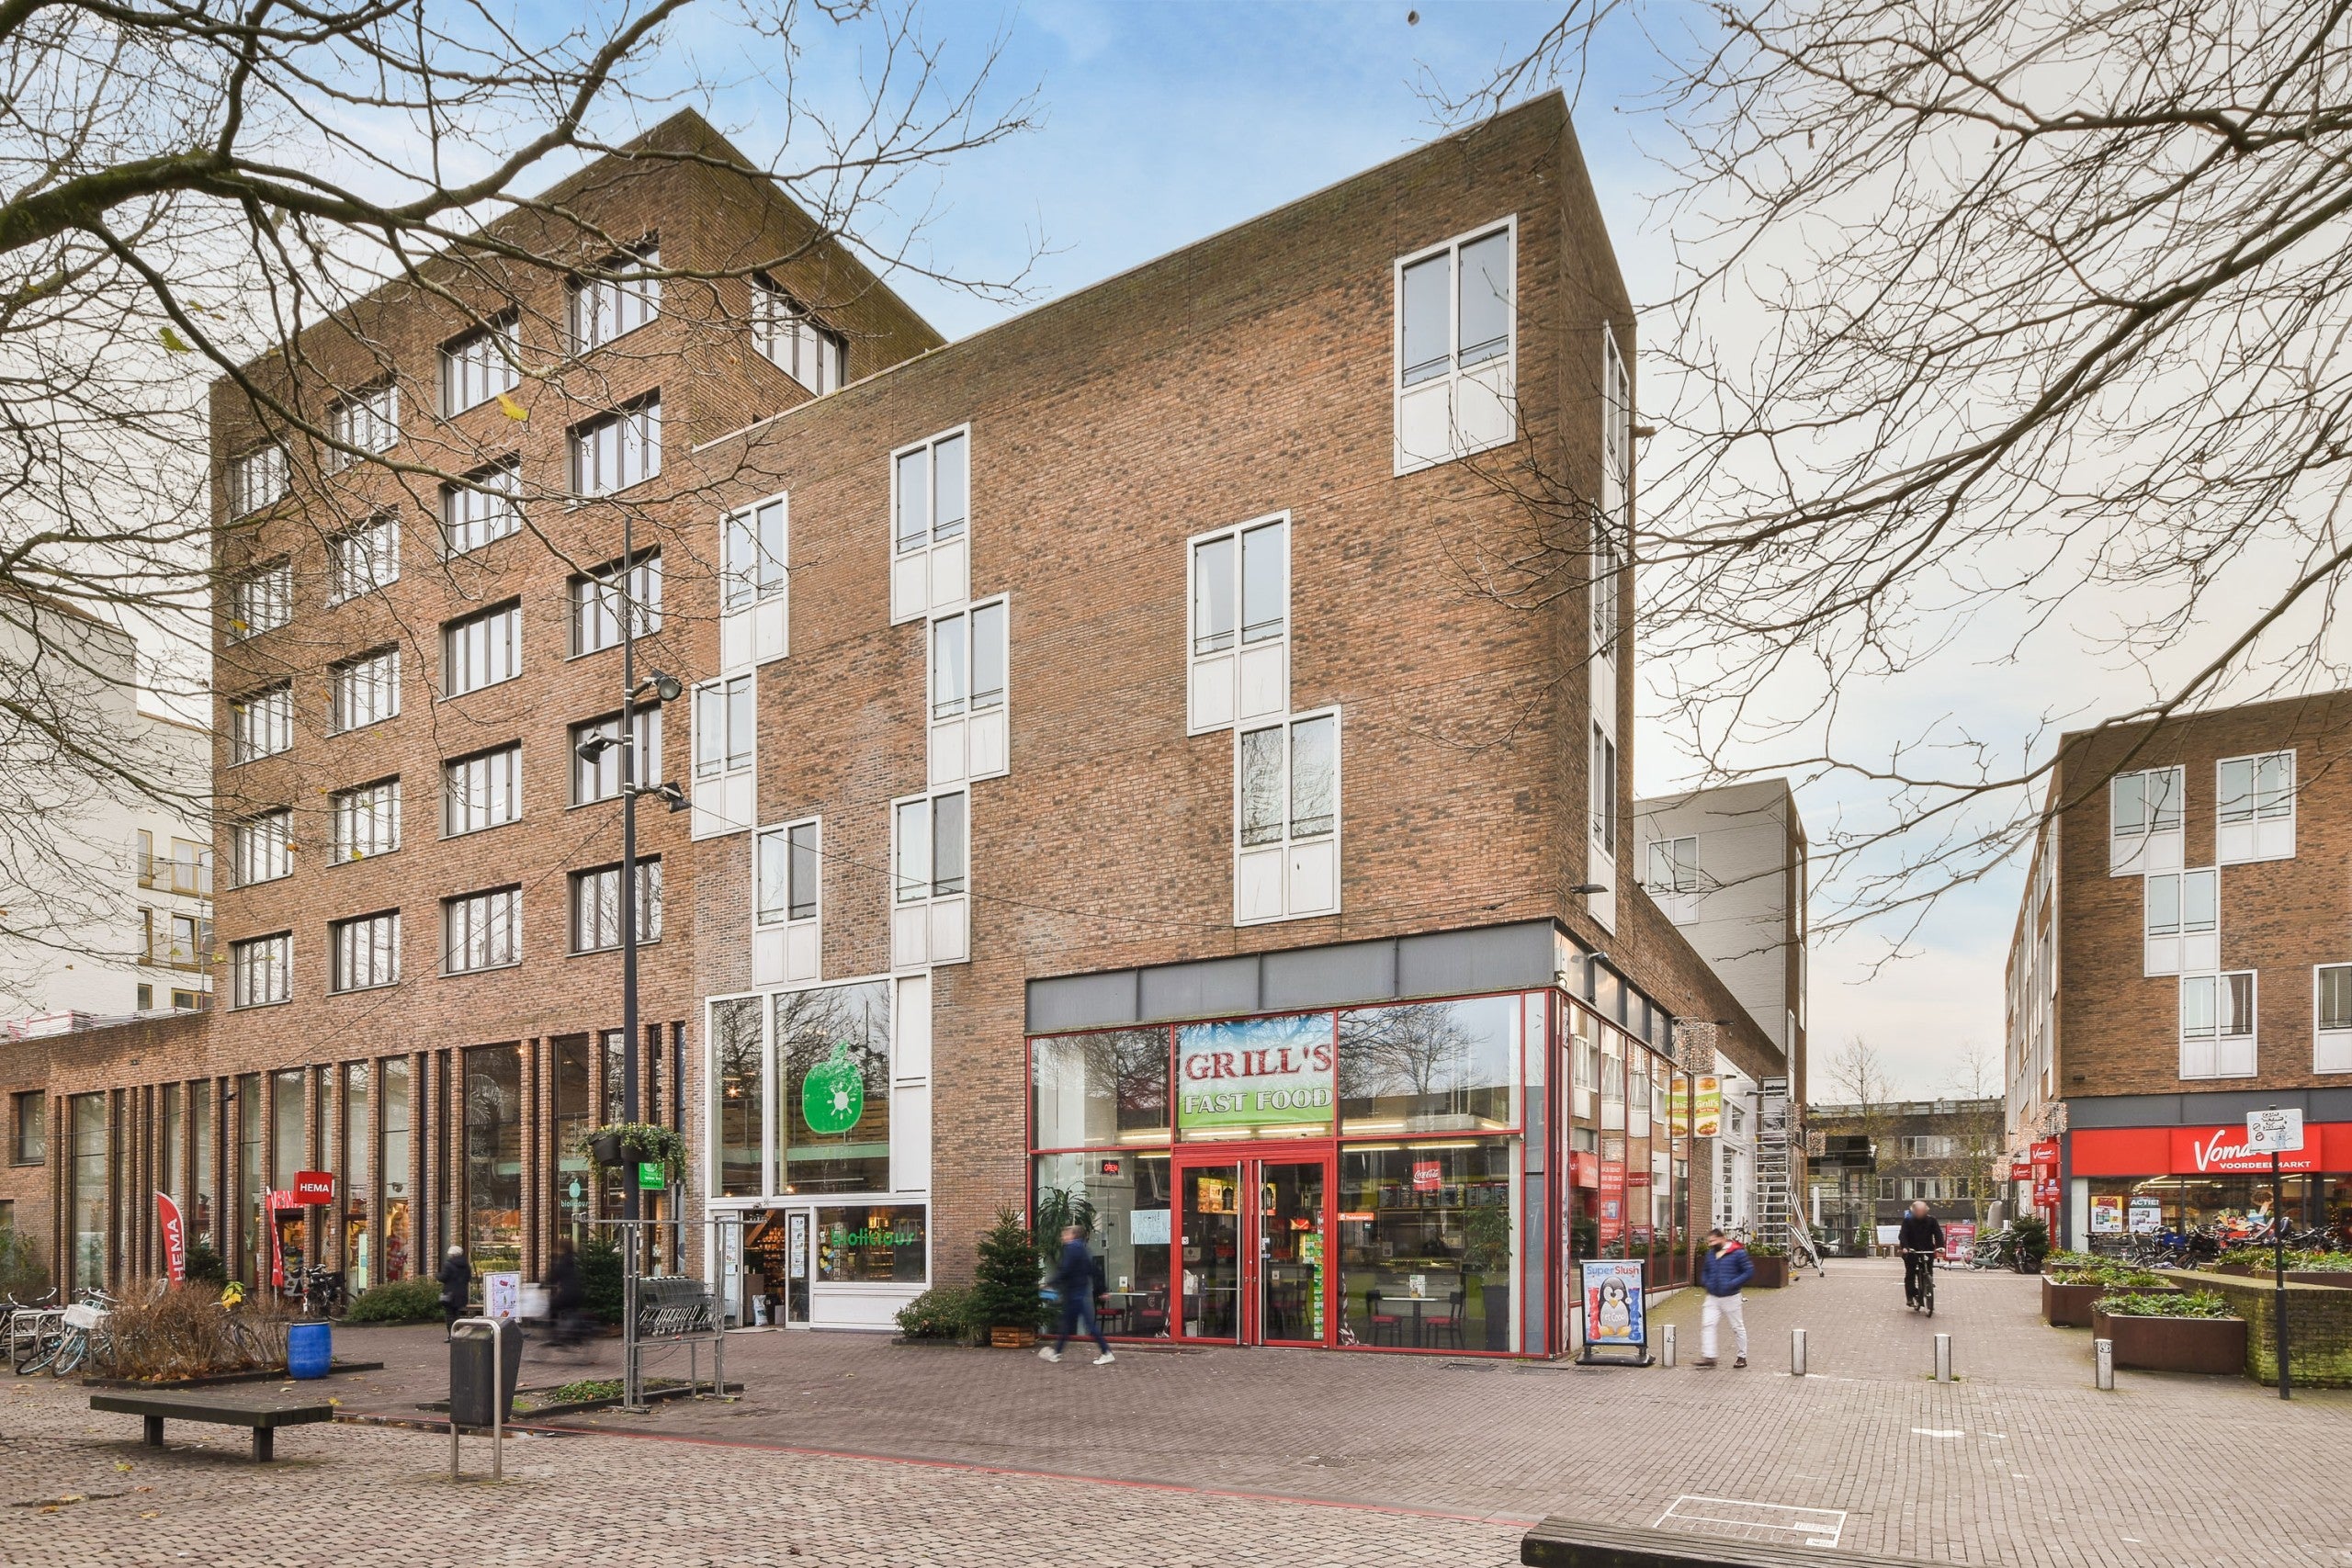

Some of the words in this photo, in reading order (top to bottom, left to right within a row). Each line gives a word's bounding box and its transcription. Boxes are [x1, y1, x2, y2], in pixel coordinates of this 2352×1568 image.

[1185, 1043, 1332, 1080] GRILL'S
[1184, 1092, 1249, 1114] FAST
[1256, 1088, 1333, 1111] FOOD
[2194, 1129, 2272, 1171] Voma
[1103, 1164, 1118, 1172] OPEN
[300, 1183, 330, 1192] HEMA
[166, 1218, 186, 1282] HEMA
[831, 1227, 915, 1247] biolicious
